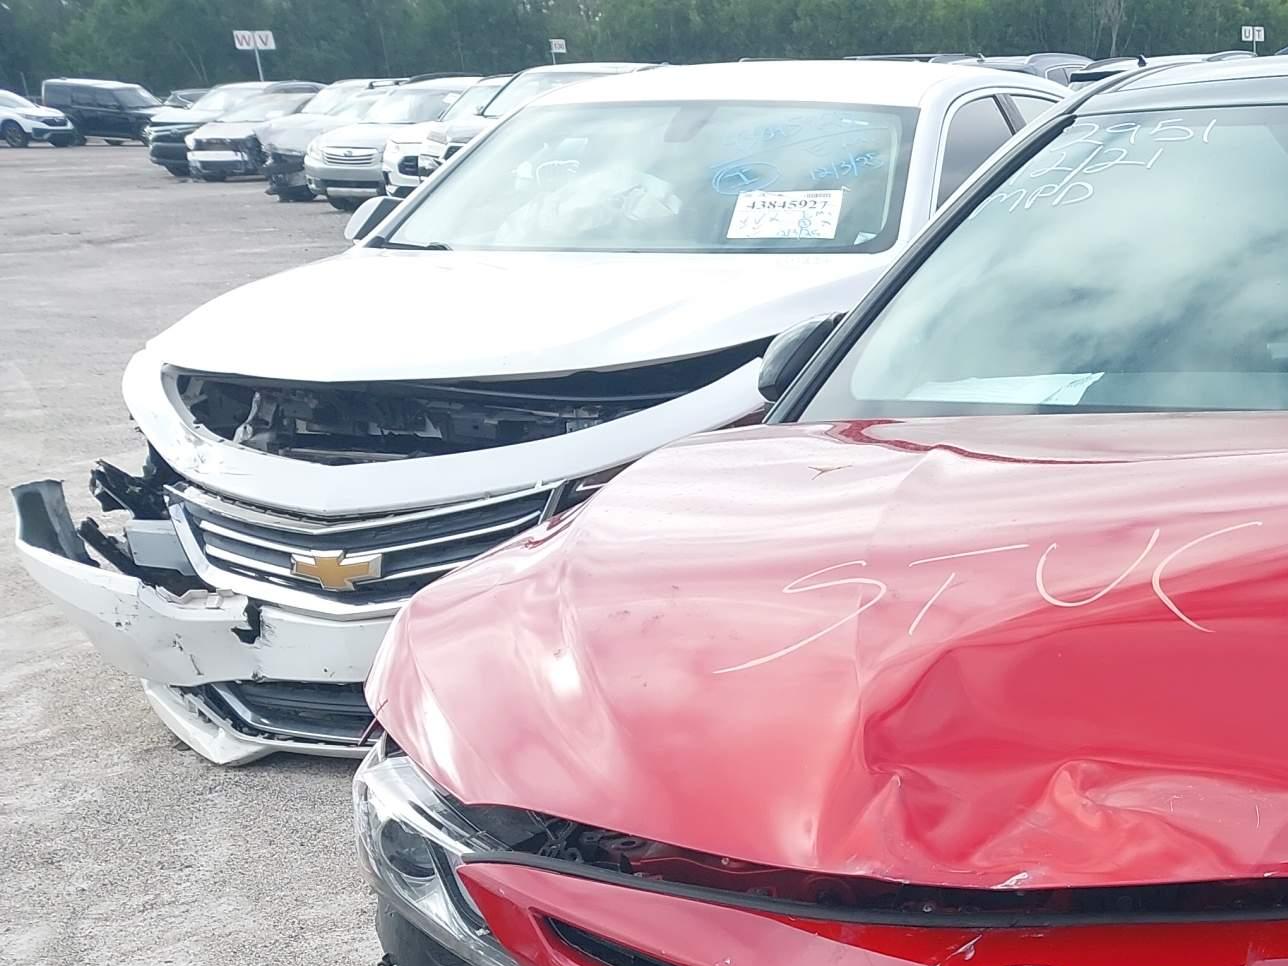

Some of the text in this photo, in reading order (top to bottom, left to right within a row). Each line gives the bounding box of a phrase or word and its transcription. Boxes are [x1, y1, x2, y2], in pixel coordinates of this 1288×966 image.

[235, 33, 270, 47] W V
[1243, 27, 1262, 40] U T
[1050, 118, 1217, 152] 2951
[745, 199, 830, 211] 43845927
